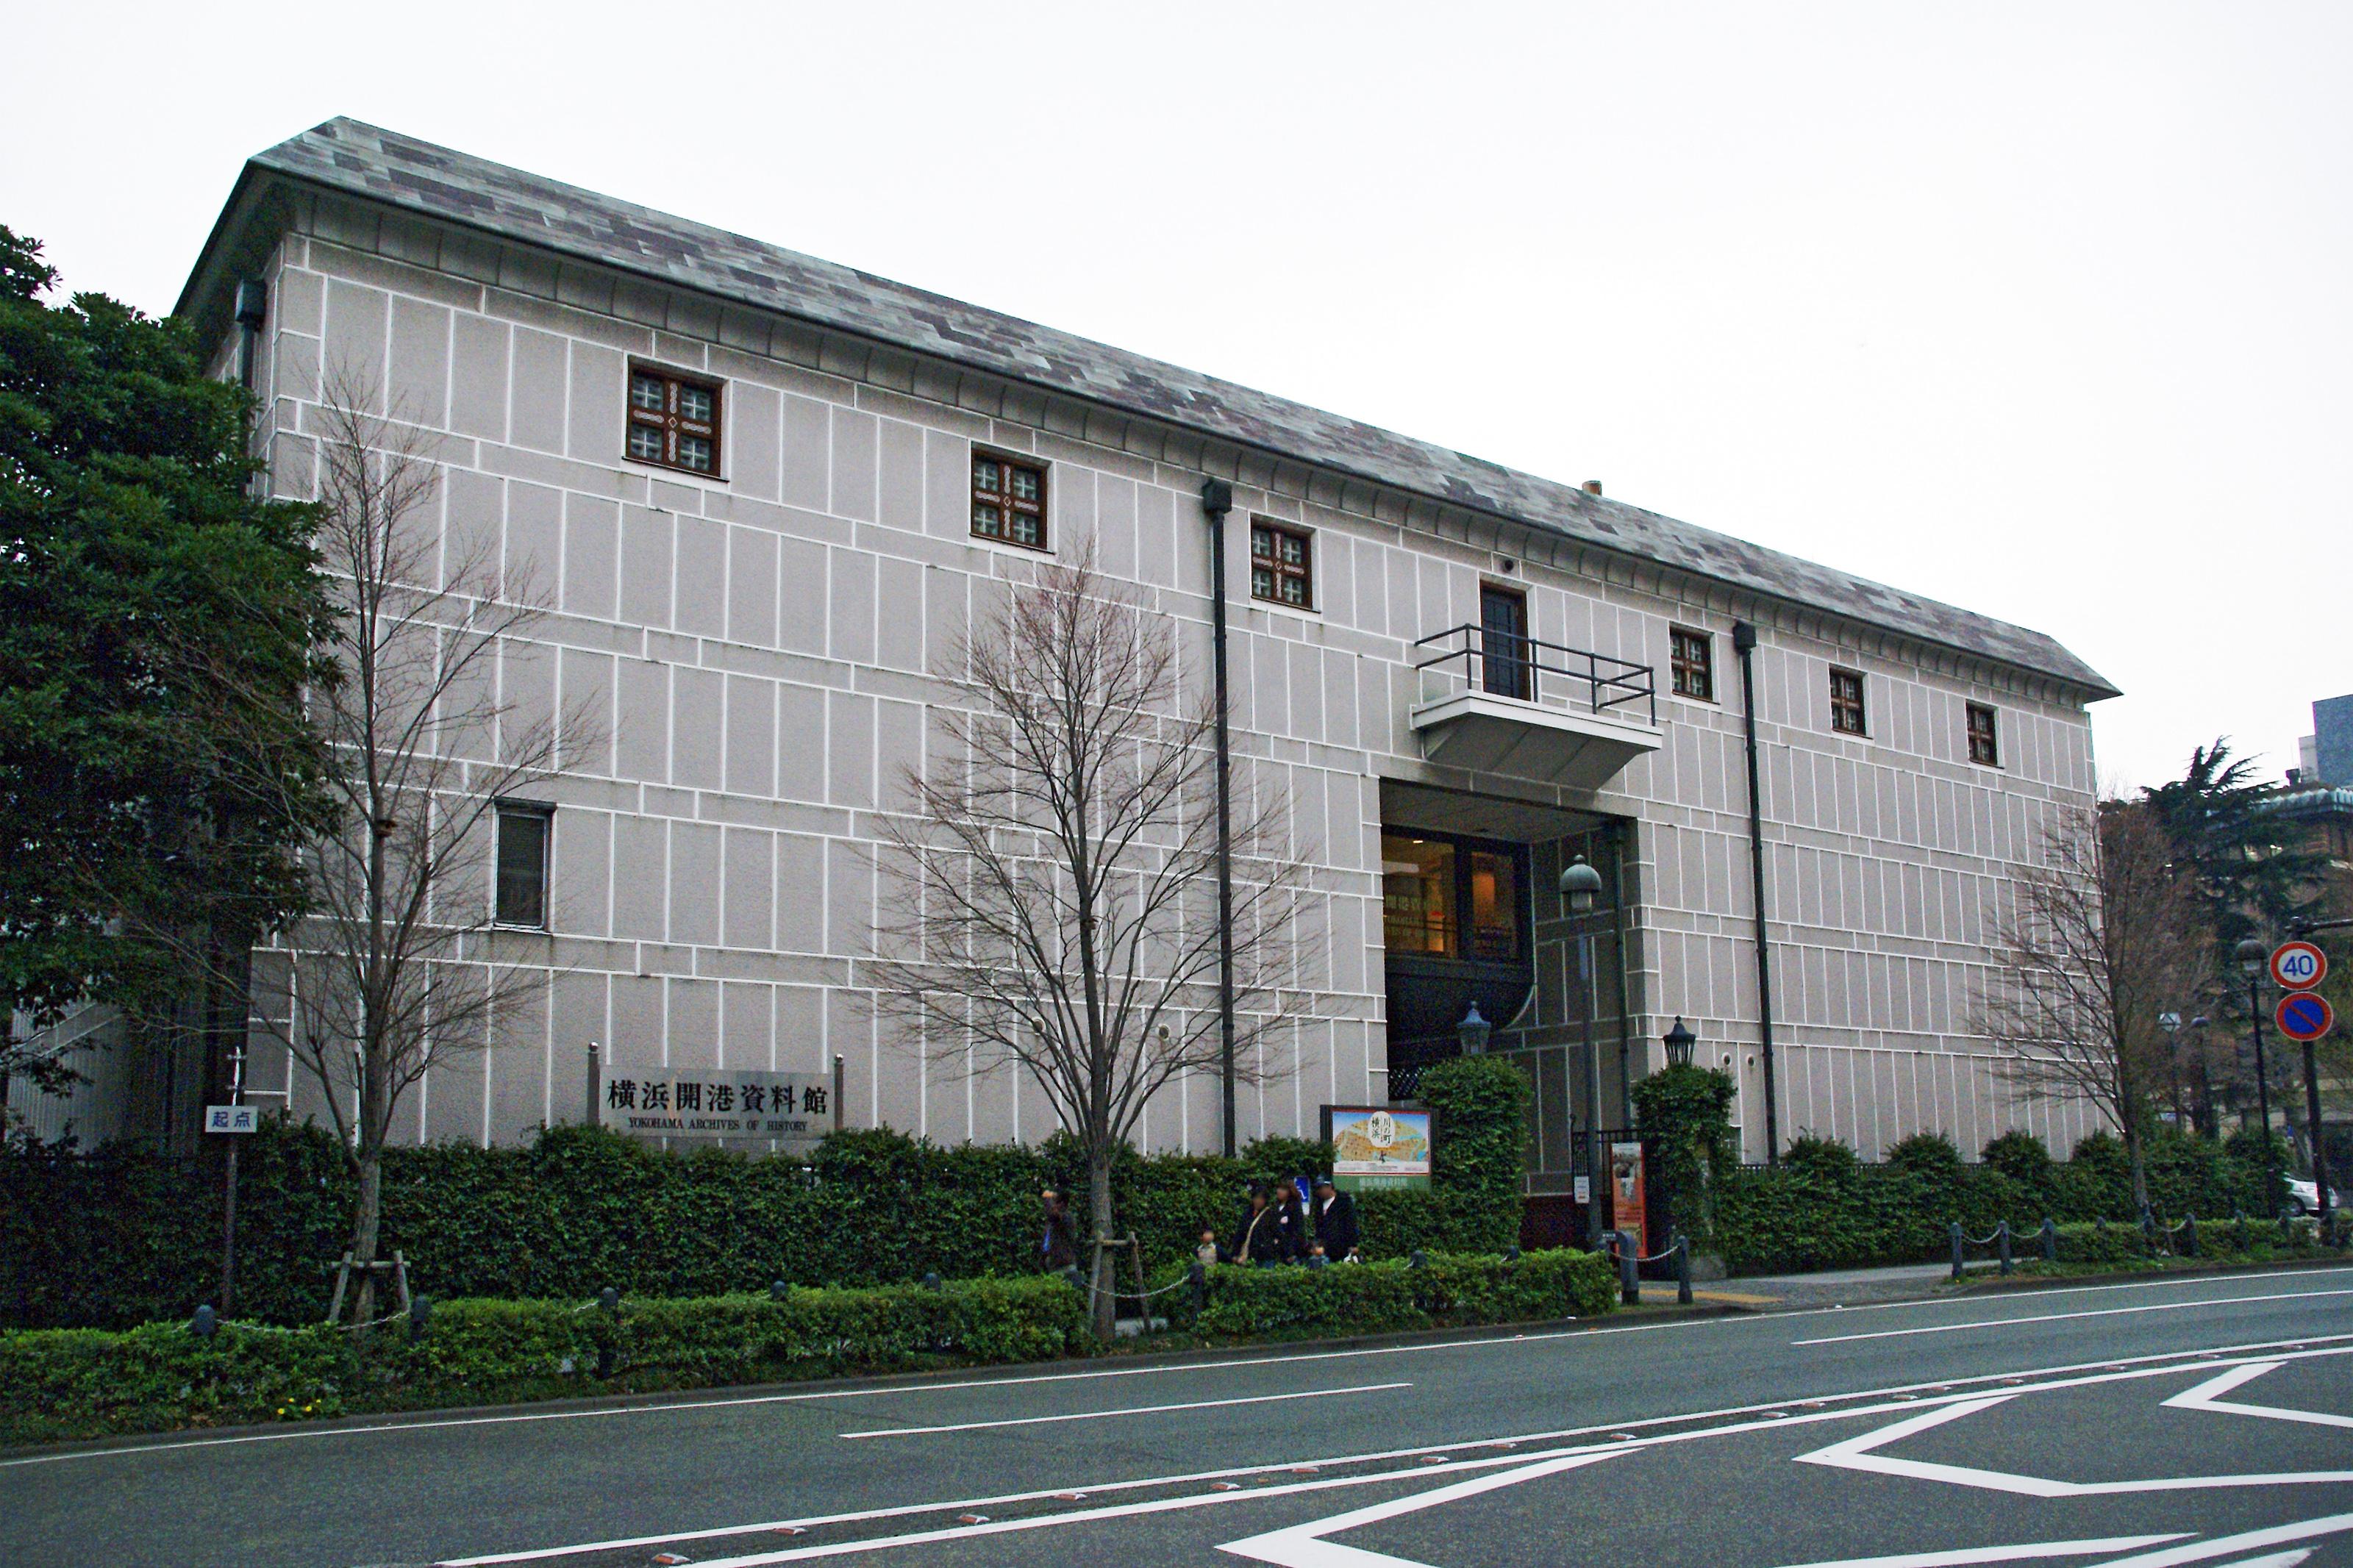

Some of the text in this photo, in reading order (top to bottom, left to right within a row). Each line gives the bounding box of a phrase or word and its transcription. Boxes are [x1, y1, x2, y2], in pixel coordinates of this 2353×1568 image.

[2283, 955, 2313, 976] 40
[607, 1079, 827, 1114] 横浜開港資料館
[212, 1111, 251, 1128] 起点
[629, 1117, 807, 1132] YOKOHAMA ARCHIVES OF HISTORY
[1371, 1117, 1380, 1139] 横浜
[1383, 1117, 1392, 1143] 川の町
